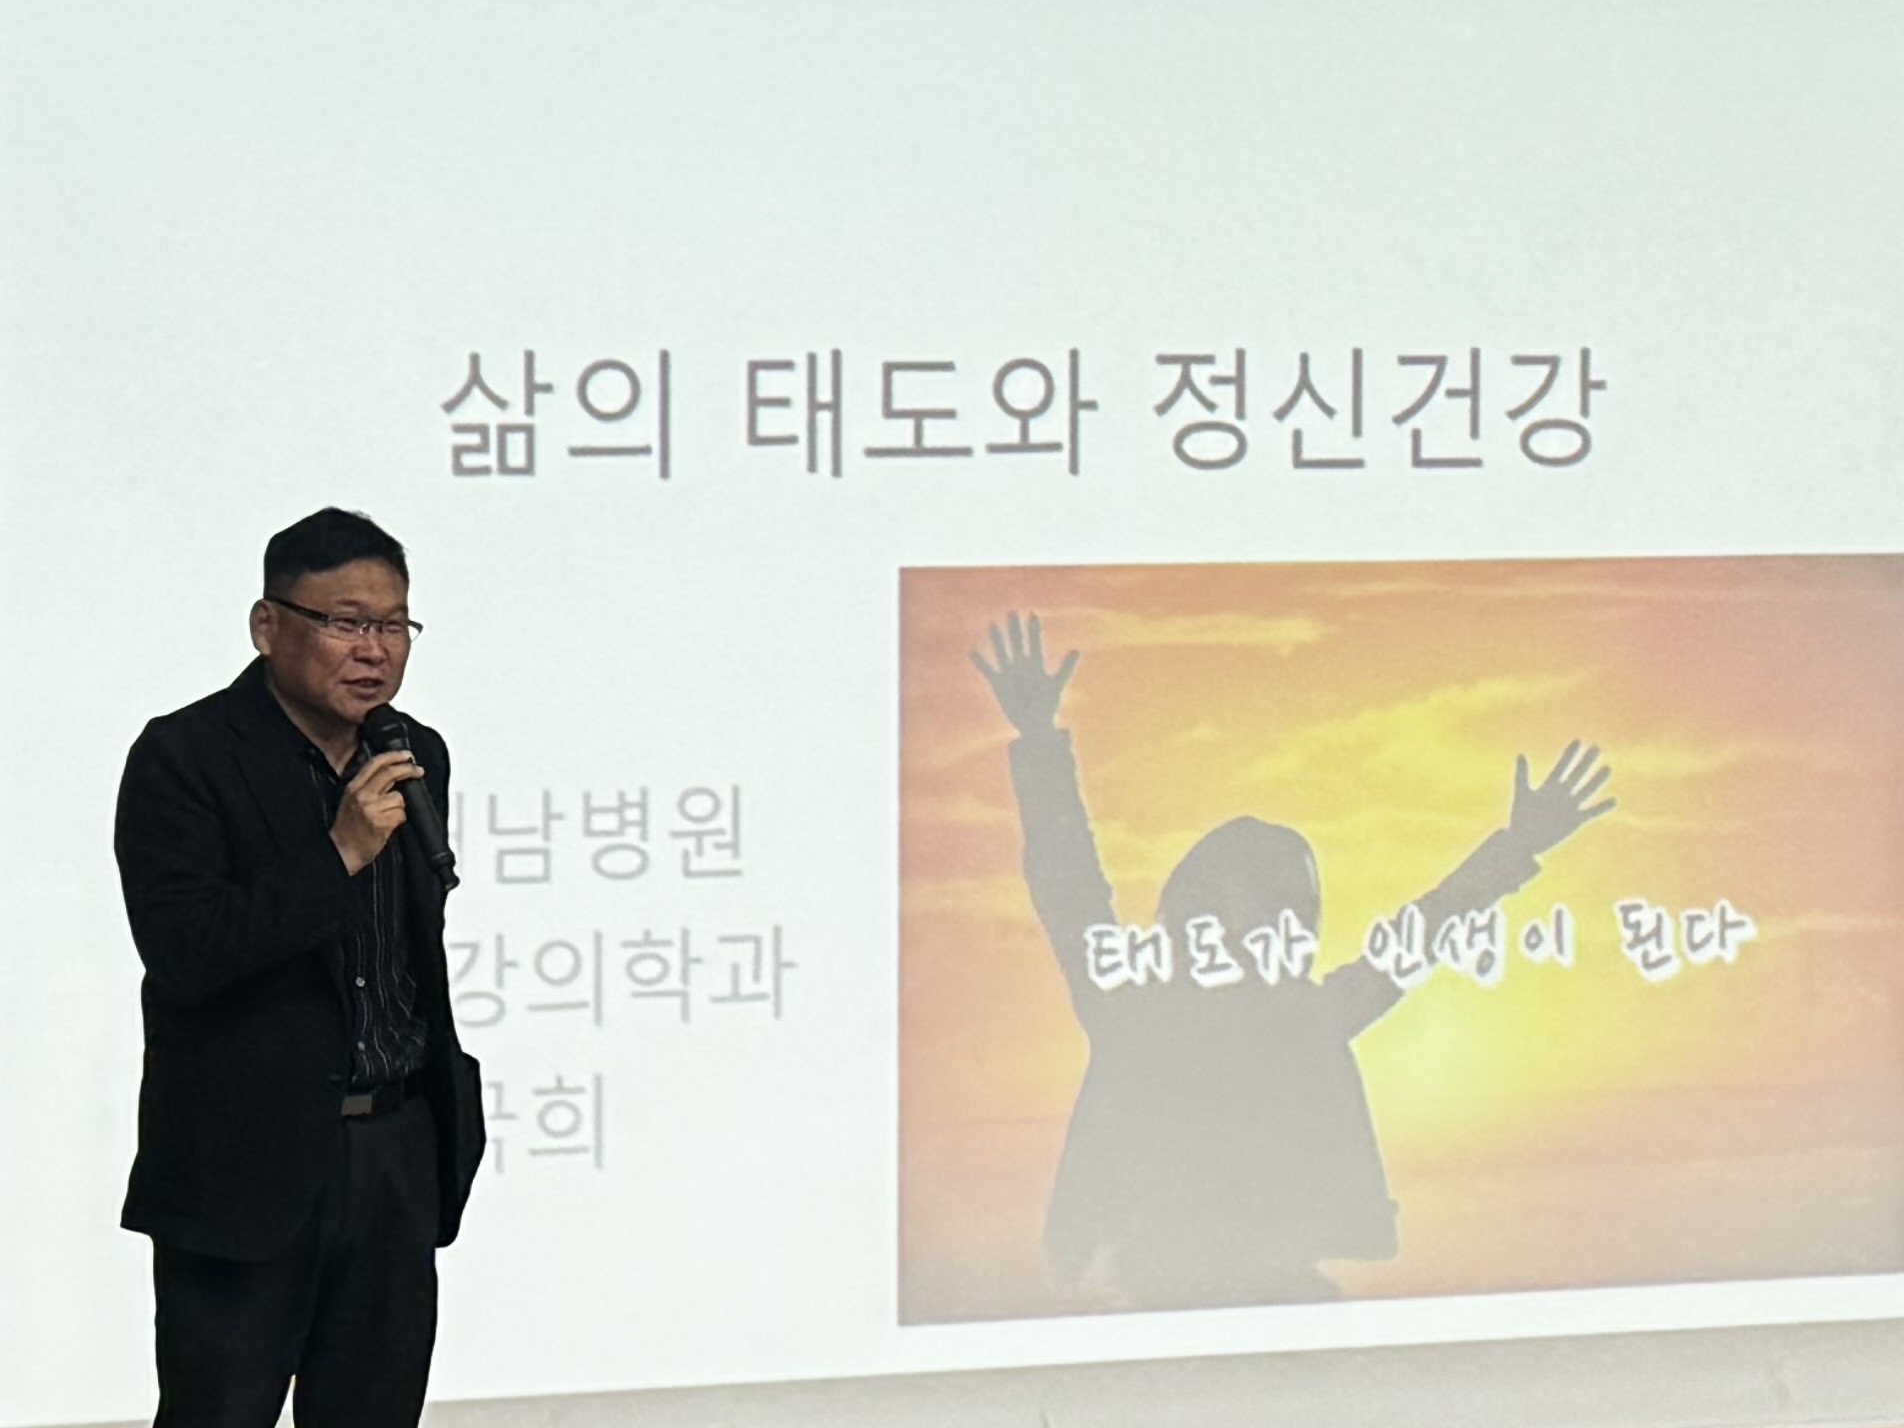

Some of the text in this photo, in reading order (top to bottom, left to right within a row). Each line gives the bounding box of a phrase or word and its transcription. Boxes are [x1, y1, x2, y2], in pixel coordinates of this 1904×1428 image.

[441, 347, 1607, 480] 삶의 태도와 정신건강
[451, 784, 744, 885] 남병원
[1086, 901, 1753, 984] 태도가 인생이 된다
